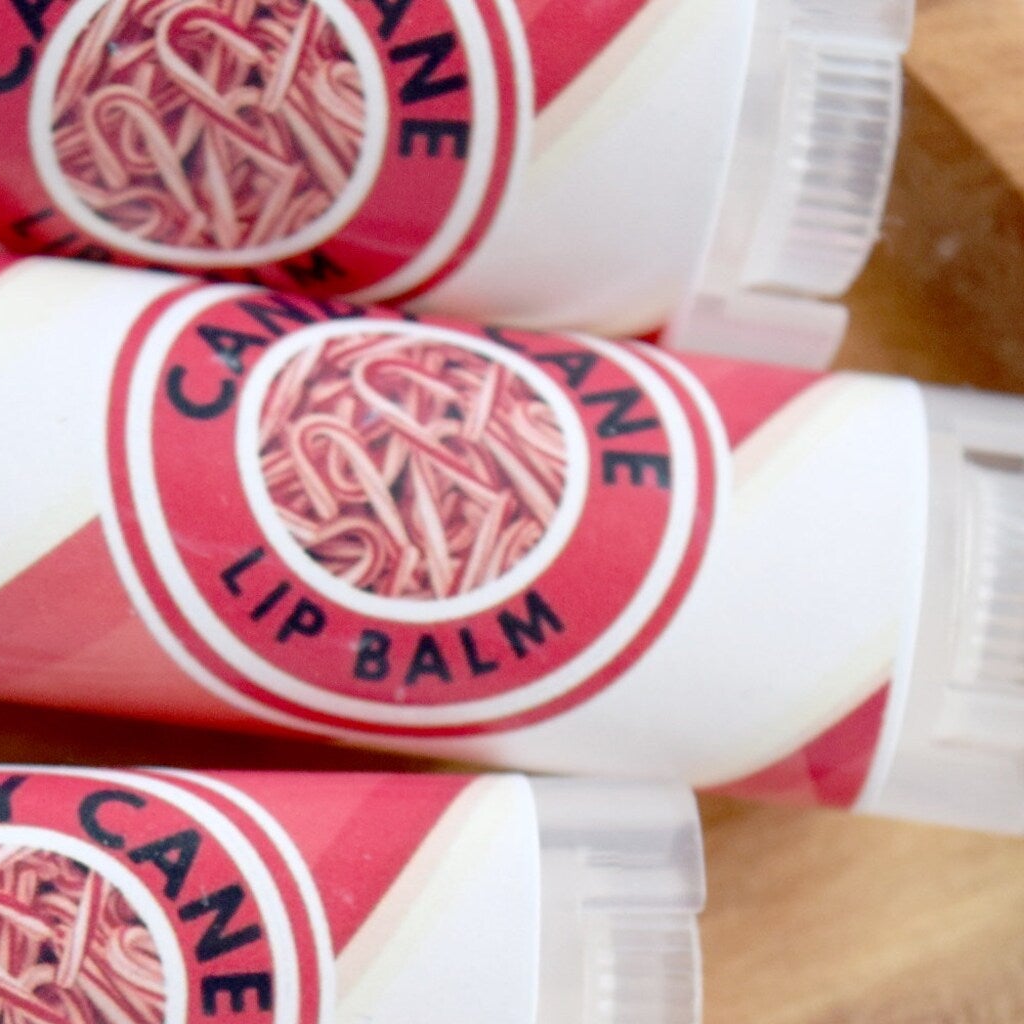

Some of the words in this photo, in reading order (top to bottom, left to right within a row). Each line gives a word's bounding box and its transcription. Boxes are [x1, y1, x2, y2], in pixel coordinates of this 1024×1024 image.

[371, 0, 470, 157] ANE
[166, 291, 419, 420] CAN
[221, 547, 325, 643] LIP
[353, 590, 564, 686] BALM
[78, 790, 273, 1016] CANE
